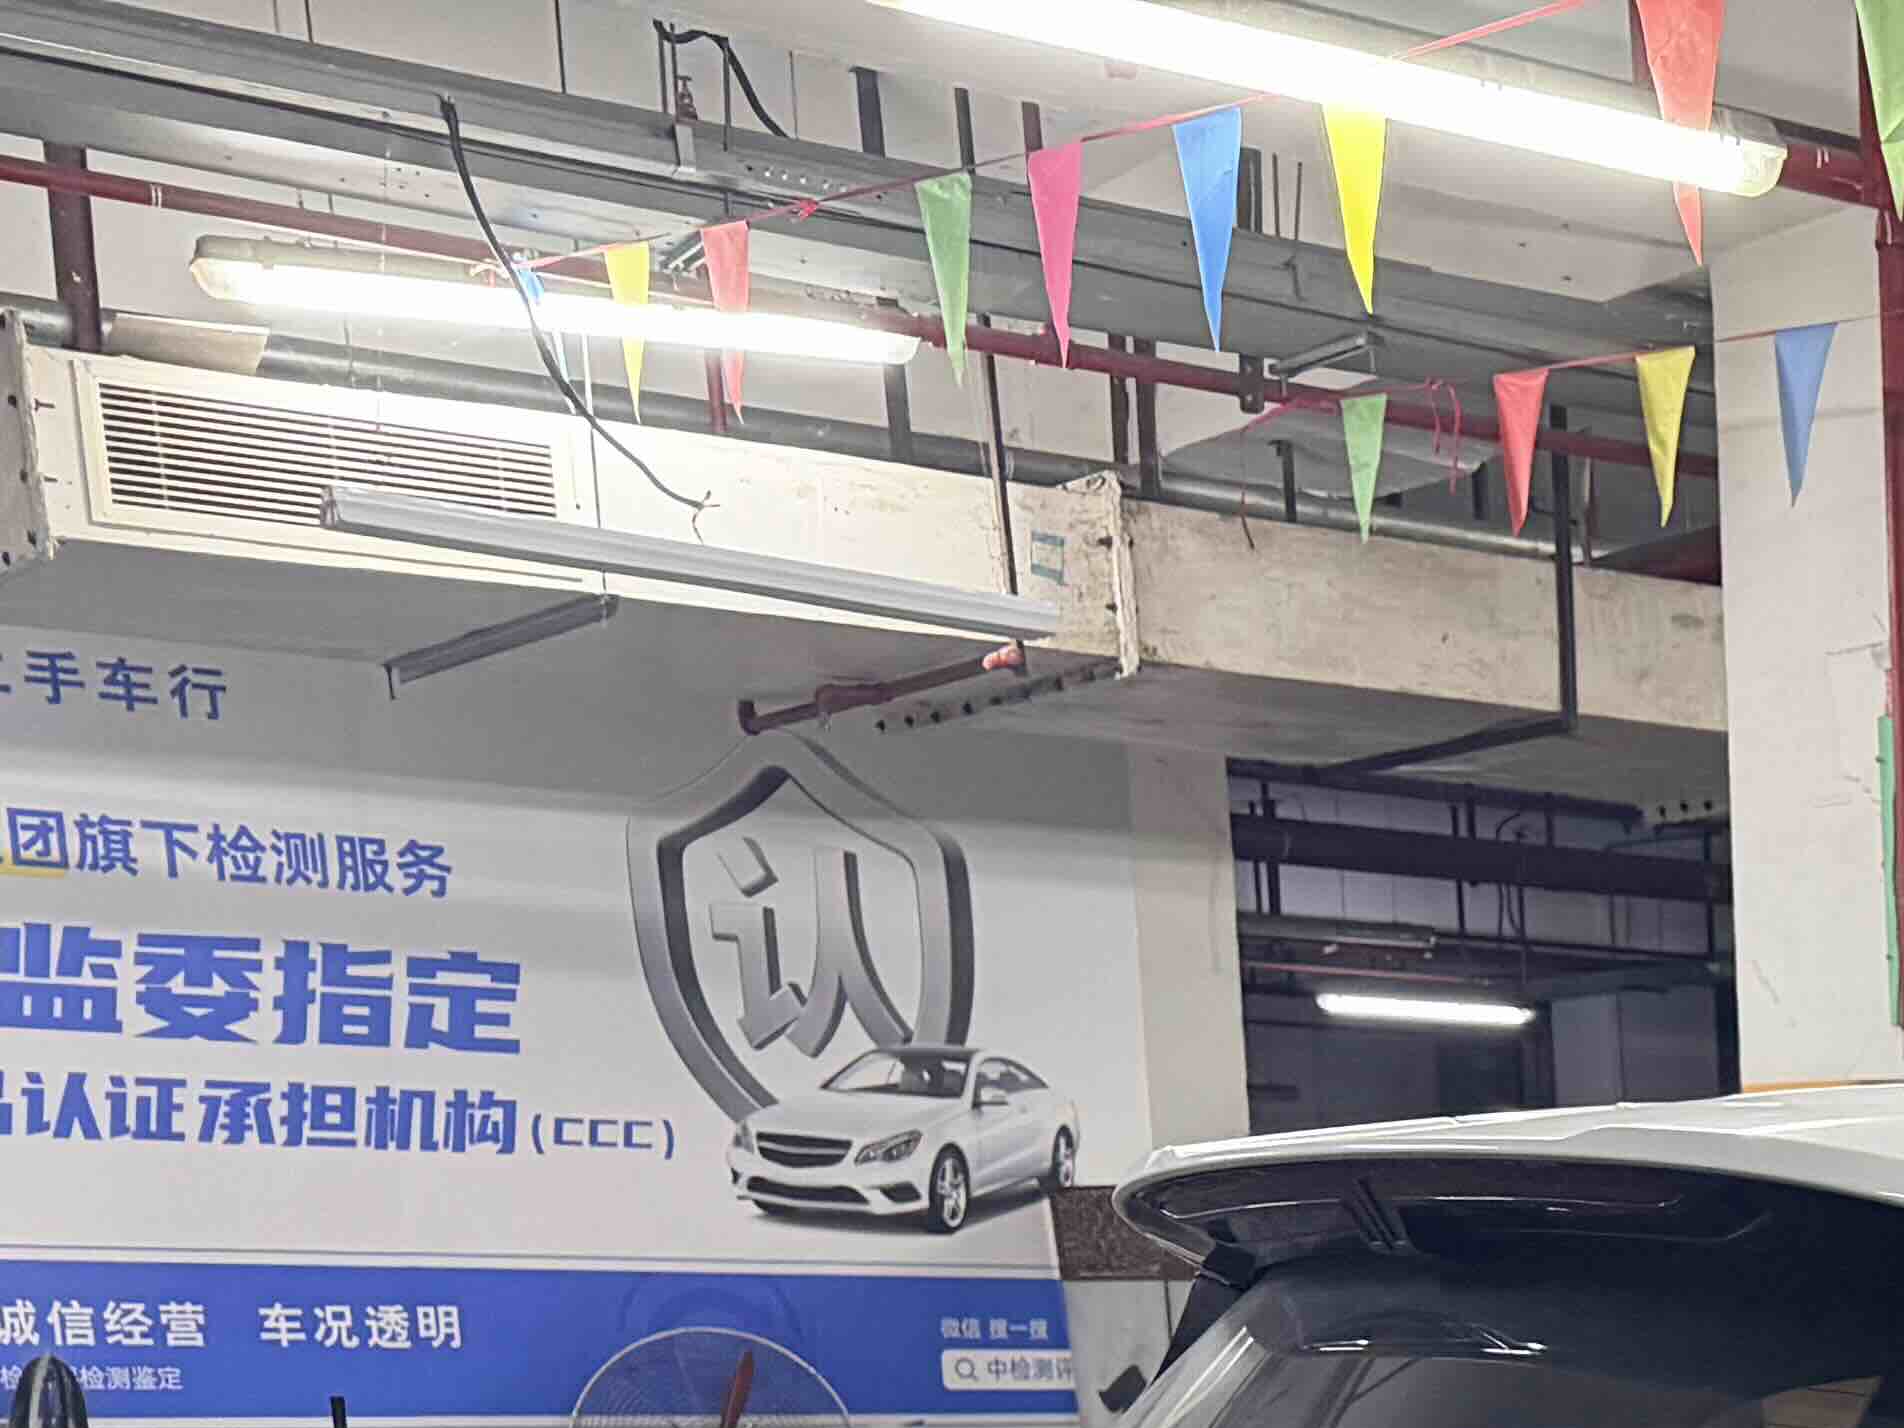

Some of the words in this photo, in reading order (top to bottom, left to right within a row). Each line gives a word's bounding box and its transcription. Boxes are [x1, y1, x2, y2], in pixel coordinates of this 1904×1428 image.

[0, 650, 226, 720] 手车行
[709, 836, 914, 1058] 认
[258, 1303, 464, 1350] 车况透明
